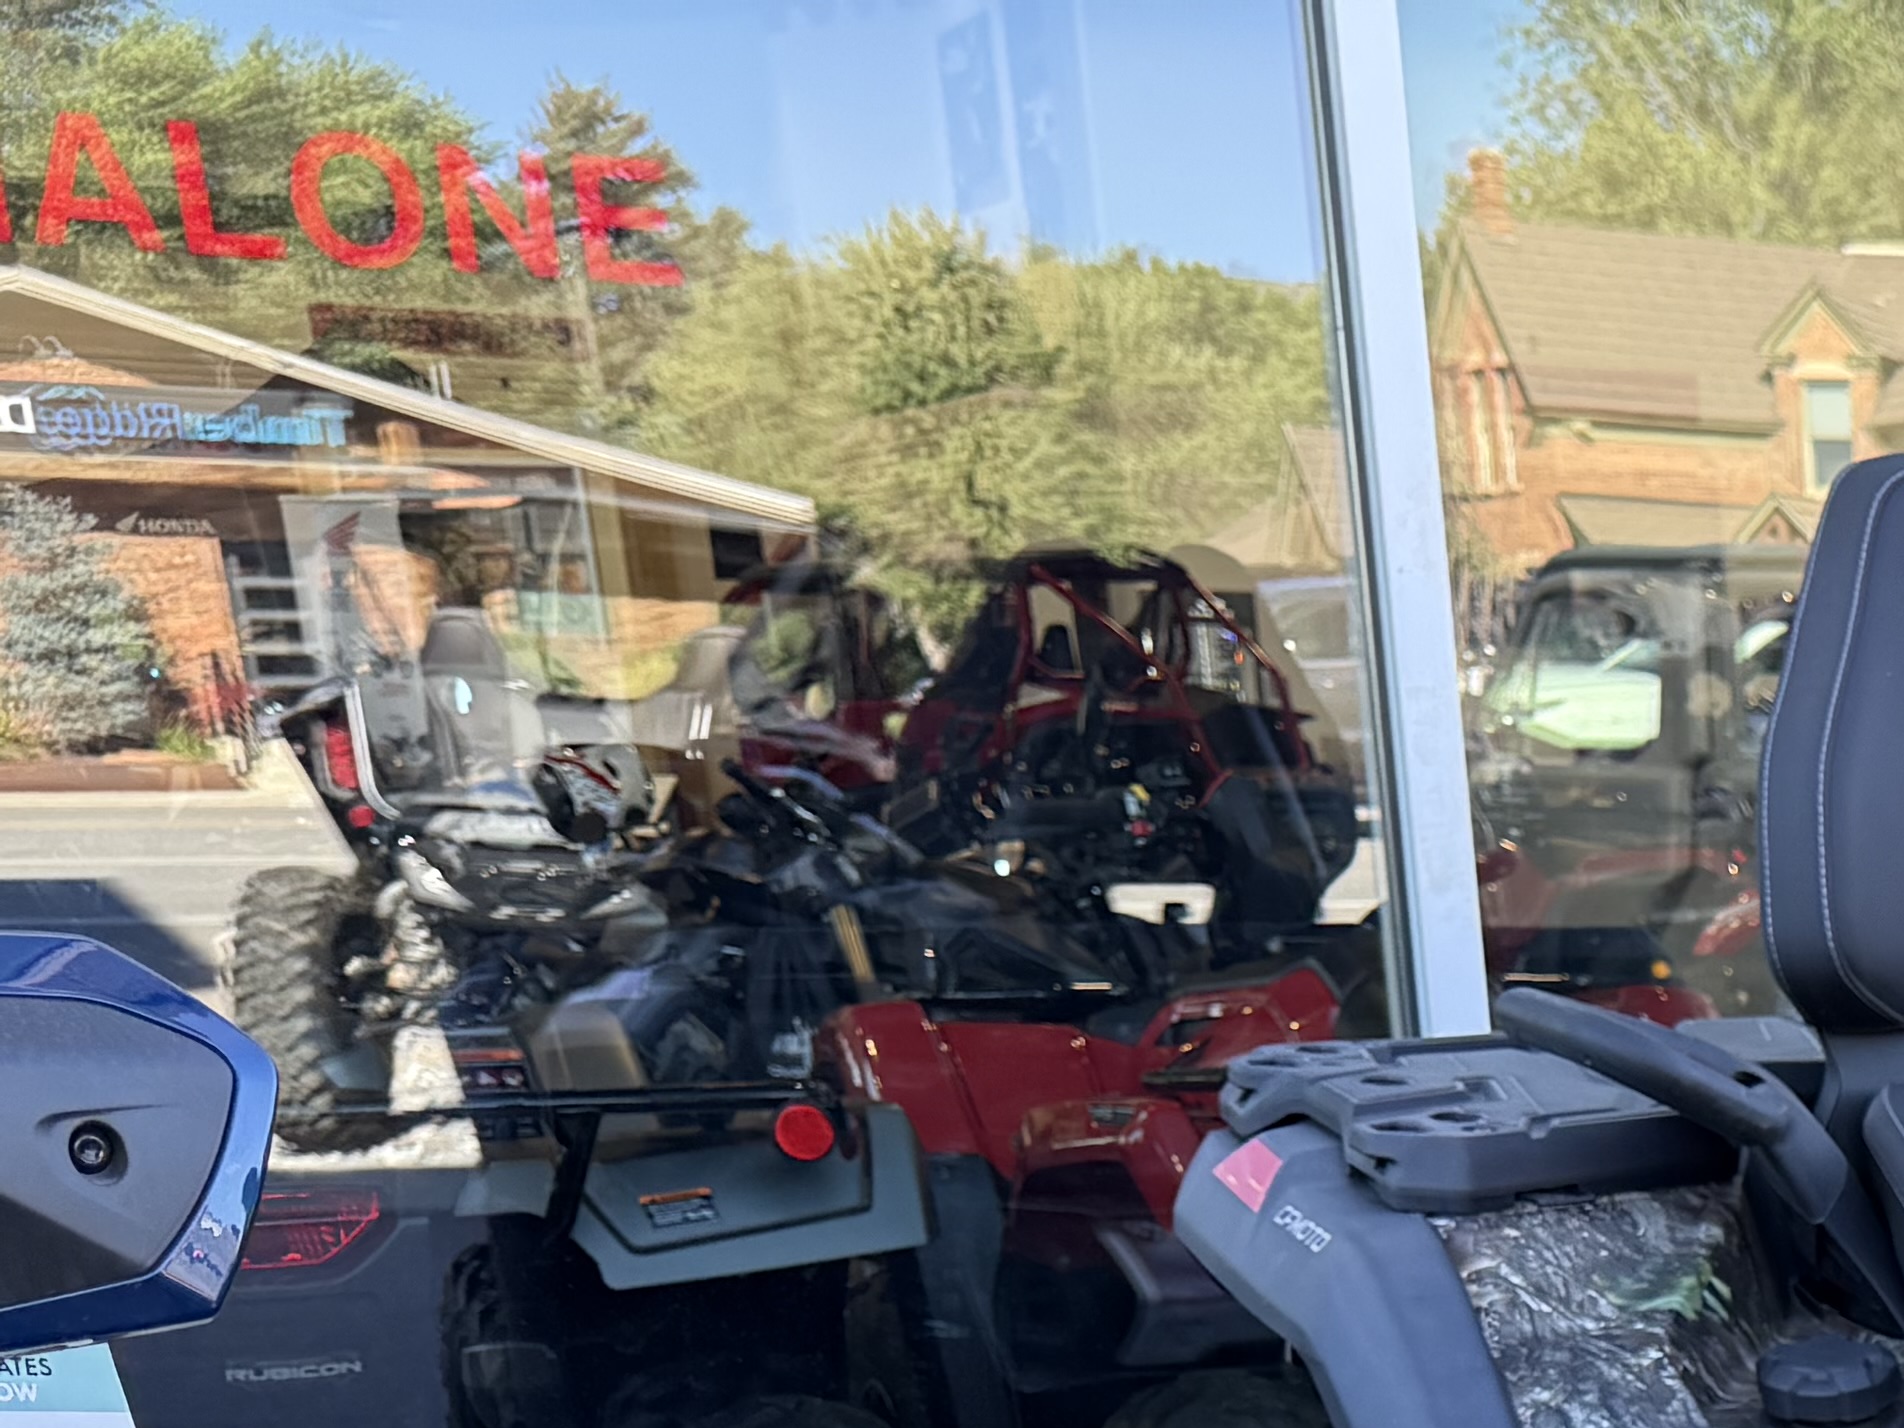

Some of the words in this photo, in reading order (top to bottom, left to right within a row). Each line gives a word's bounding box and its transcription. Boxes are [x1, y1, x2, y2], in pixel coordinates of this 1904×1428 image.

[0, 110, 685, 287] ALONE
[1273, 1204, 1333, 1254] CFMOTO
[224, 1360, 363, 1382] RUBICON
